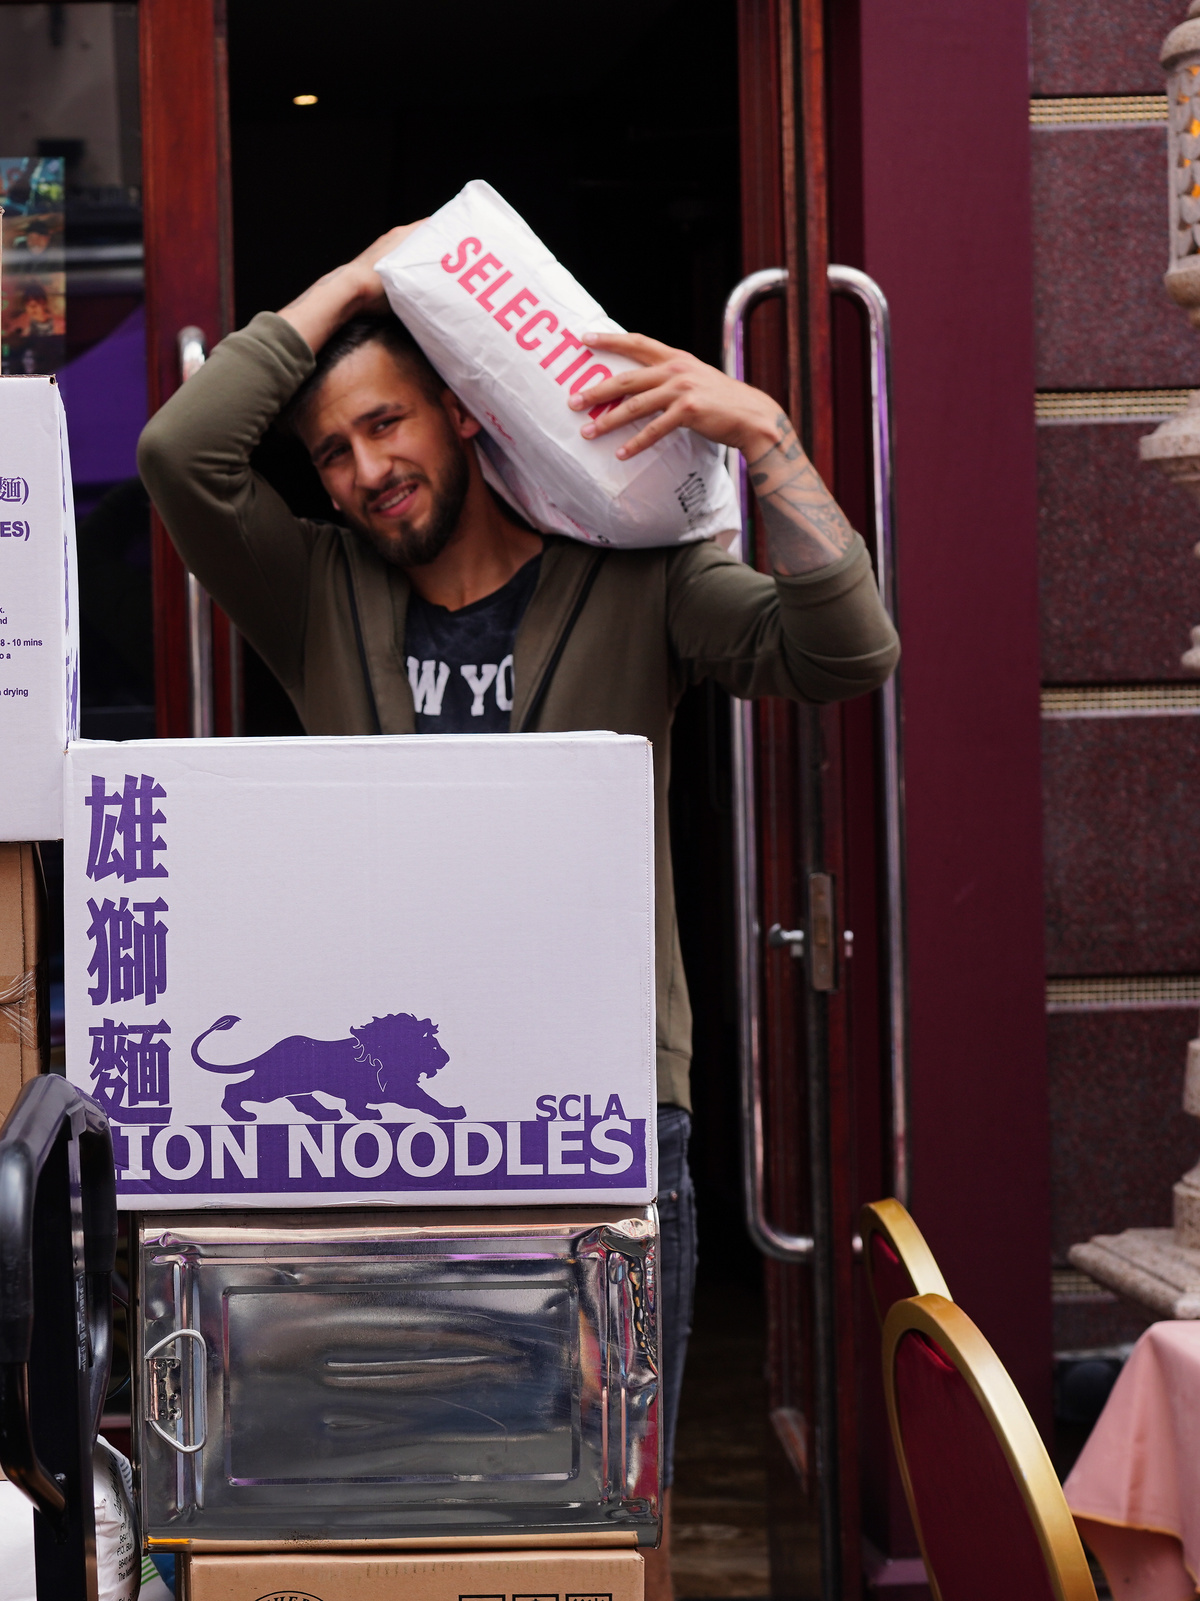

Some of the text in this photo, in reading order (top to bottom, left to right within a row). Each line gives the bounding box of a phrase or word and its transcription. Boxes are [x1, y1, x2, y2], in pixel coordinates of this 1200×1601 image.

[85, 773, 173, 1124] 雄獅麵
[535, 1093, 627, 1121] SCLA
[115, 1116, 634, 1181] ION NOODLES
